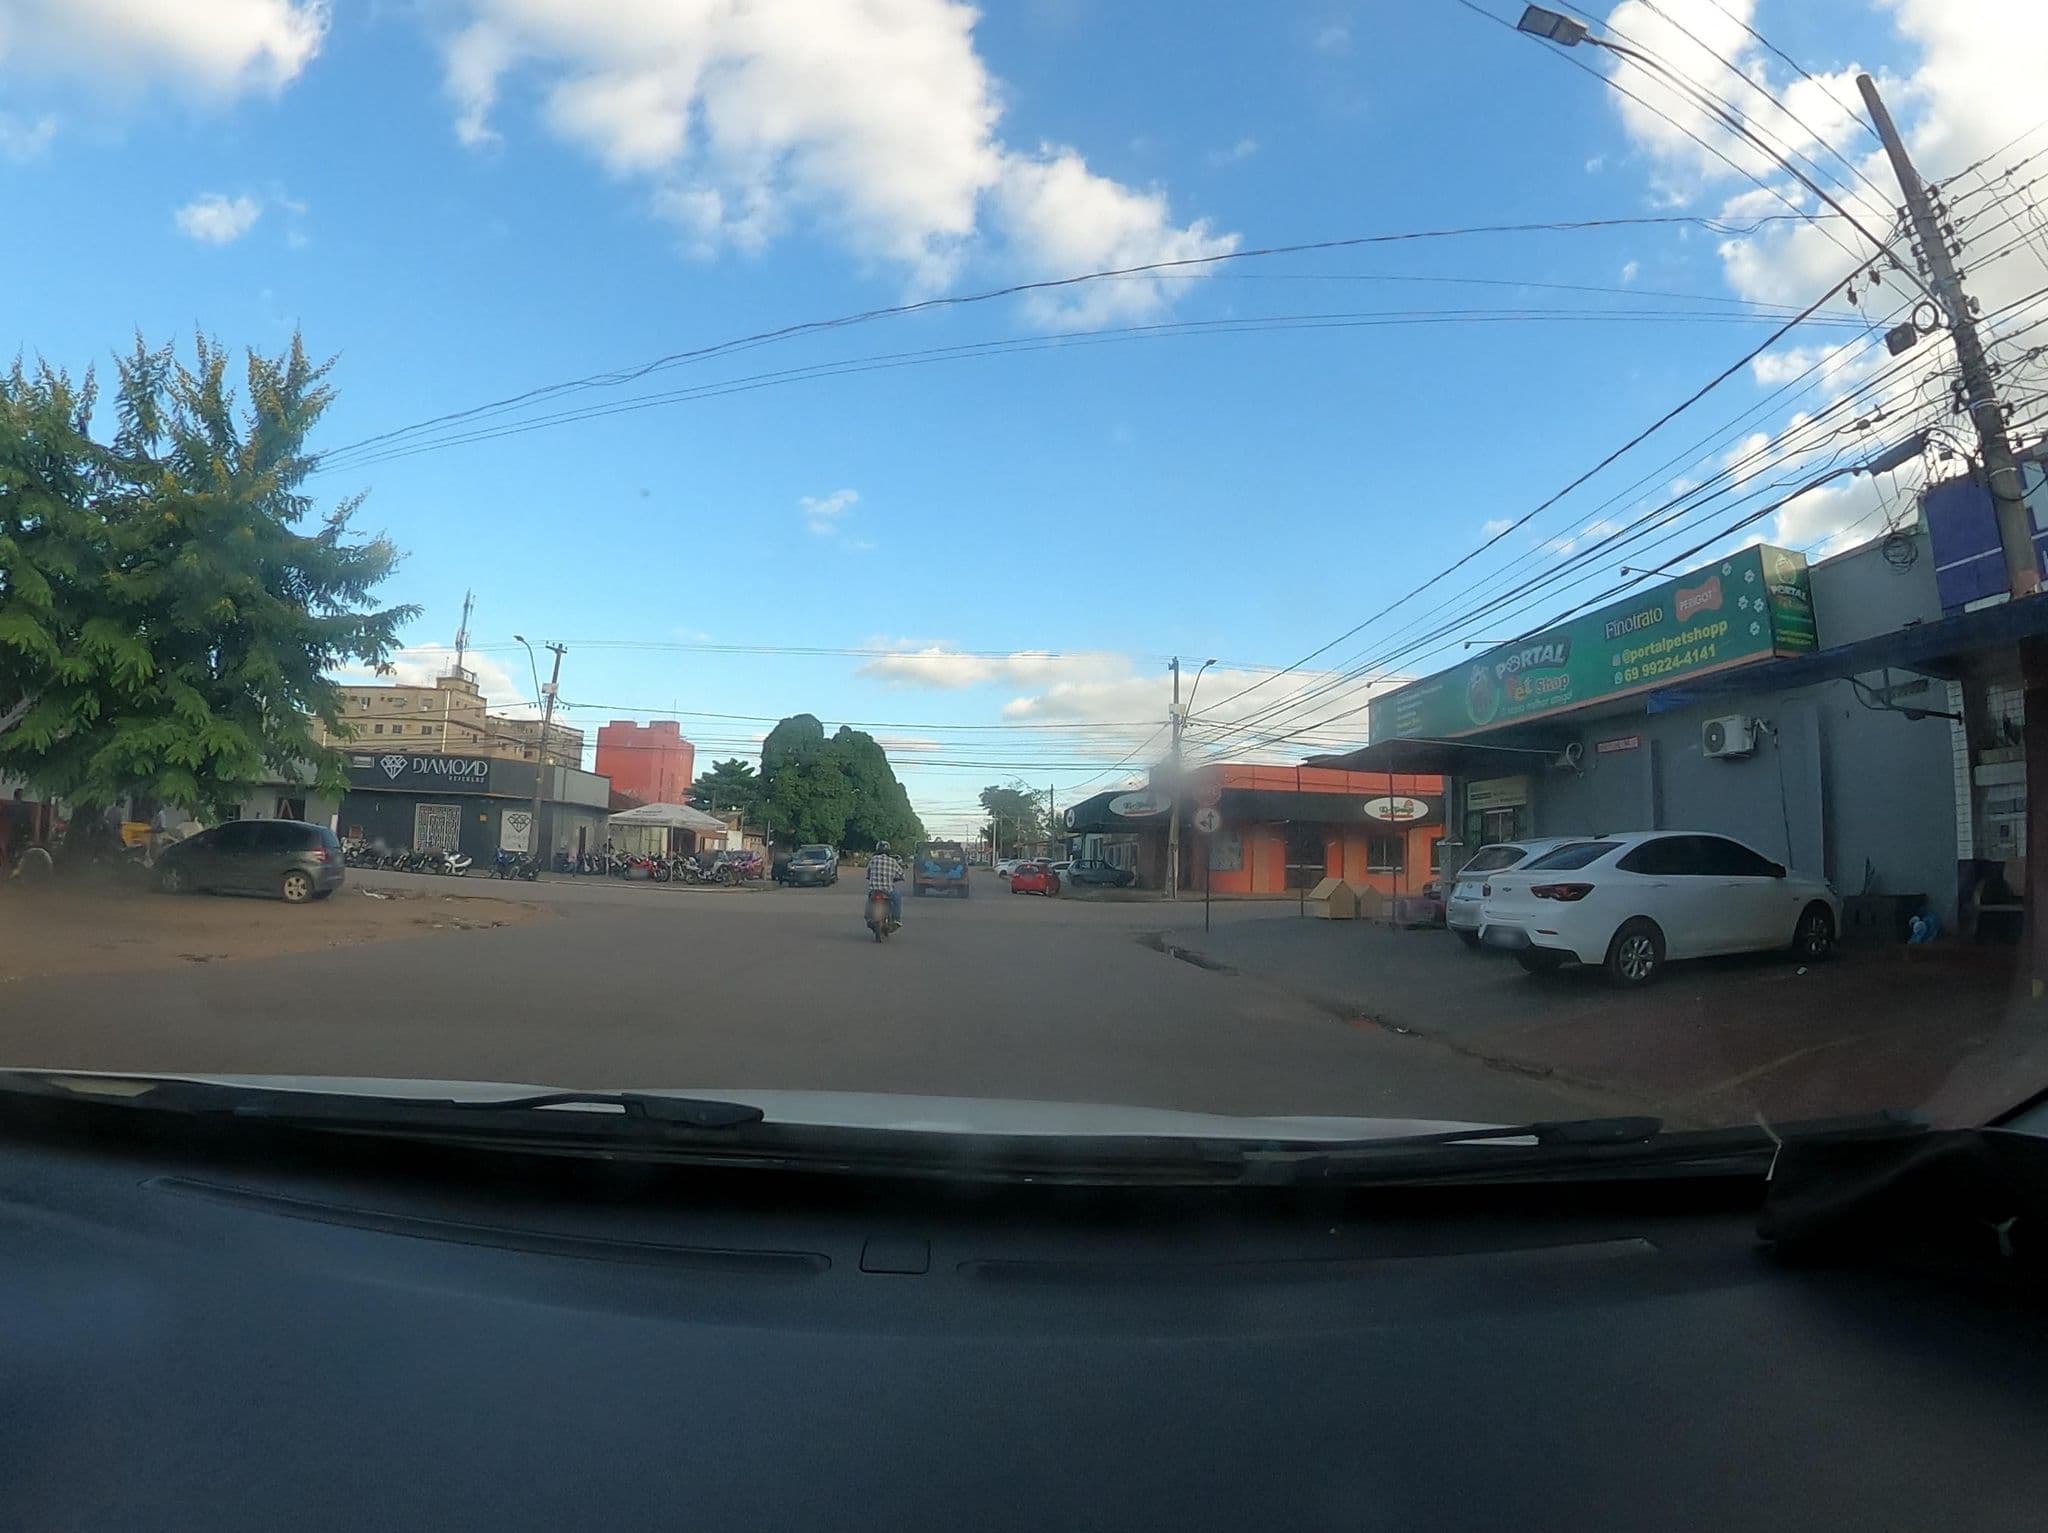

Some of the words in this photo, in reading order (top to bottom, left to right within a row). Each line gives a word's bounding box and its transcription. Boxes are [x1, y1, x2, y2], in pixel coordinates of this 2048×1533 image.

[1622, 620, 1728, 664] @portalpetshopp
[1496, 643, 1565, 680] PORTAL
[1624, 667, 1639, 682] 69
[1641, 643, 1716, 677] 99224-4141
[413, 758, 488, 776] DIAMOND
